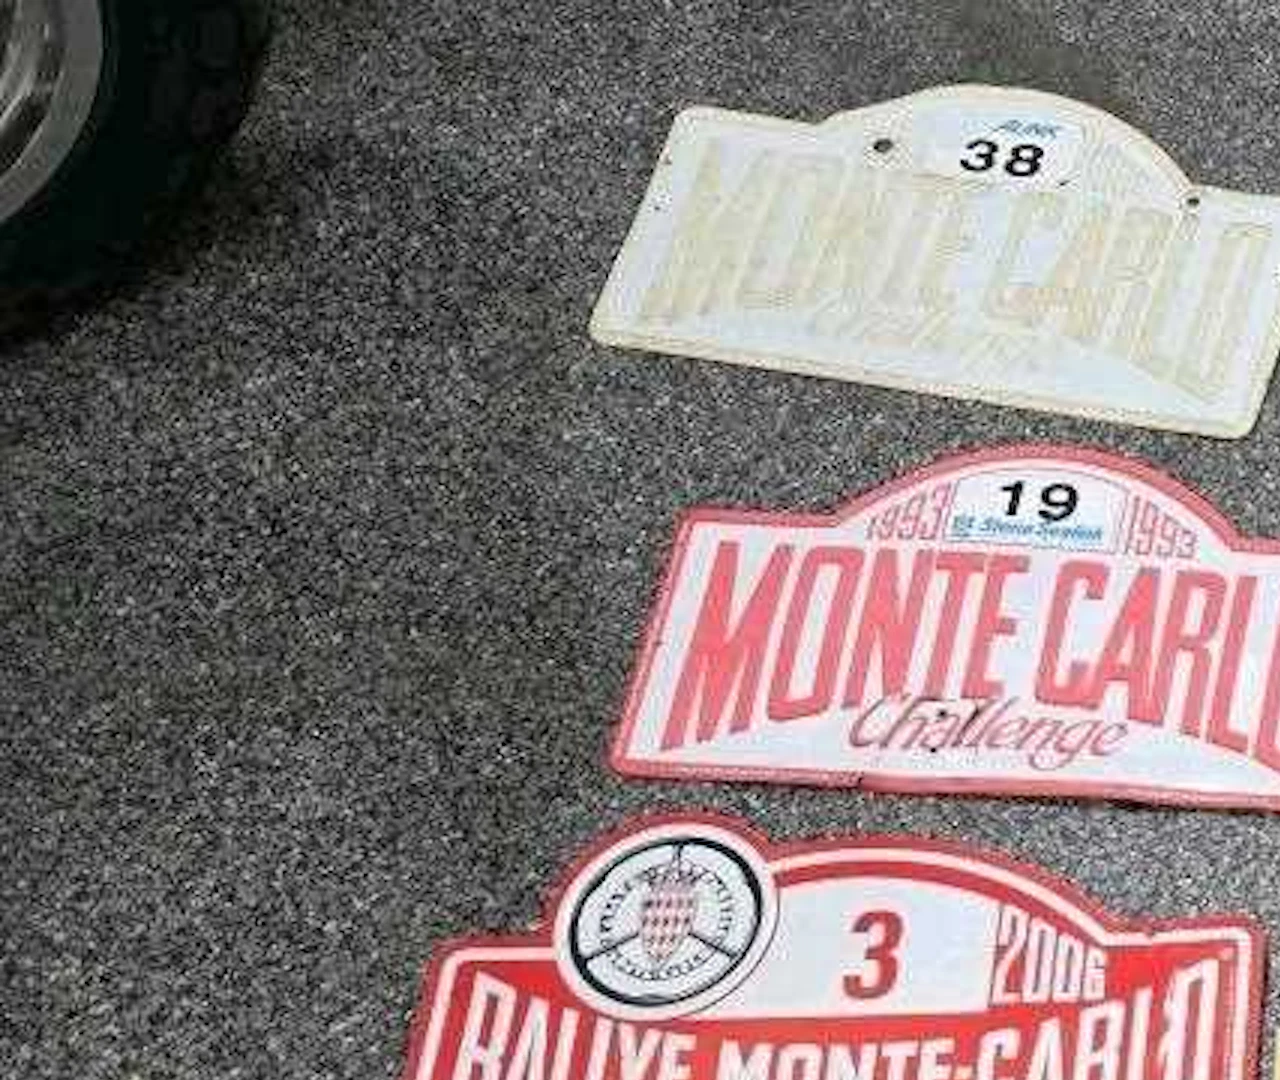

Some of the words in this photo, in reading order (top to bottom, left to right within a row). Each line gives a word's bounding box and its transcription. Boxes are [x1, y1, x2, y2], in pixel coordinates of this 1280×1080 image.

[959, 139, 1044, 177] 38
[1000, 481, 1081, 522] 19
[660, 541, 1032, 750] MONTE
[848, 692, 1130, 770] Challenge
[842, 911, 907, 999] 3
[998, 913, 1107, 1004] 2006
